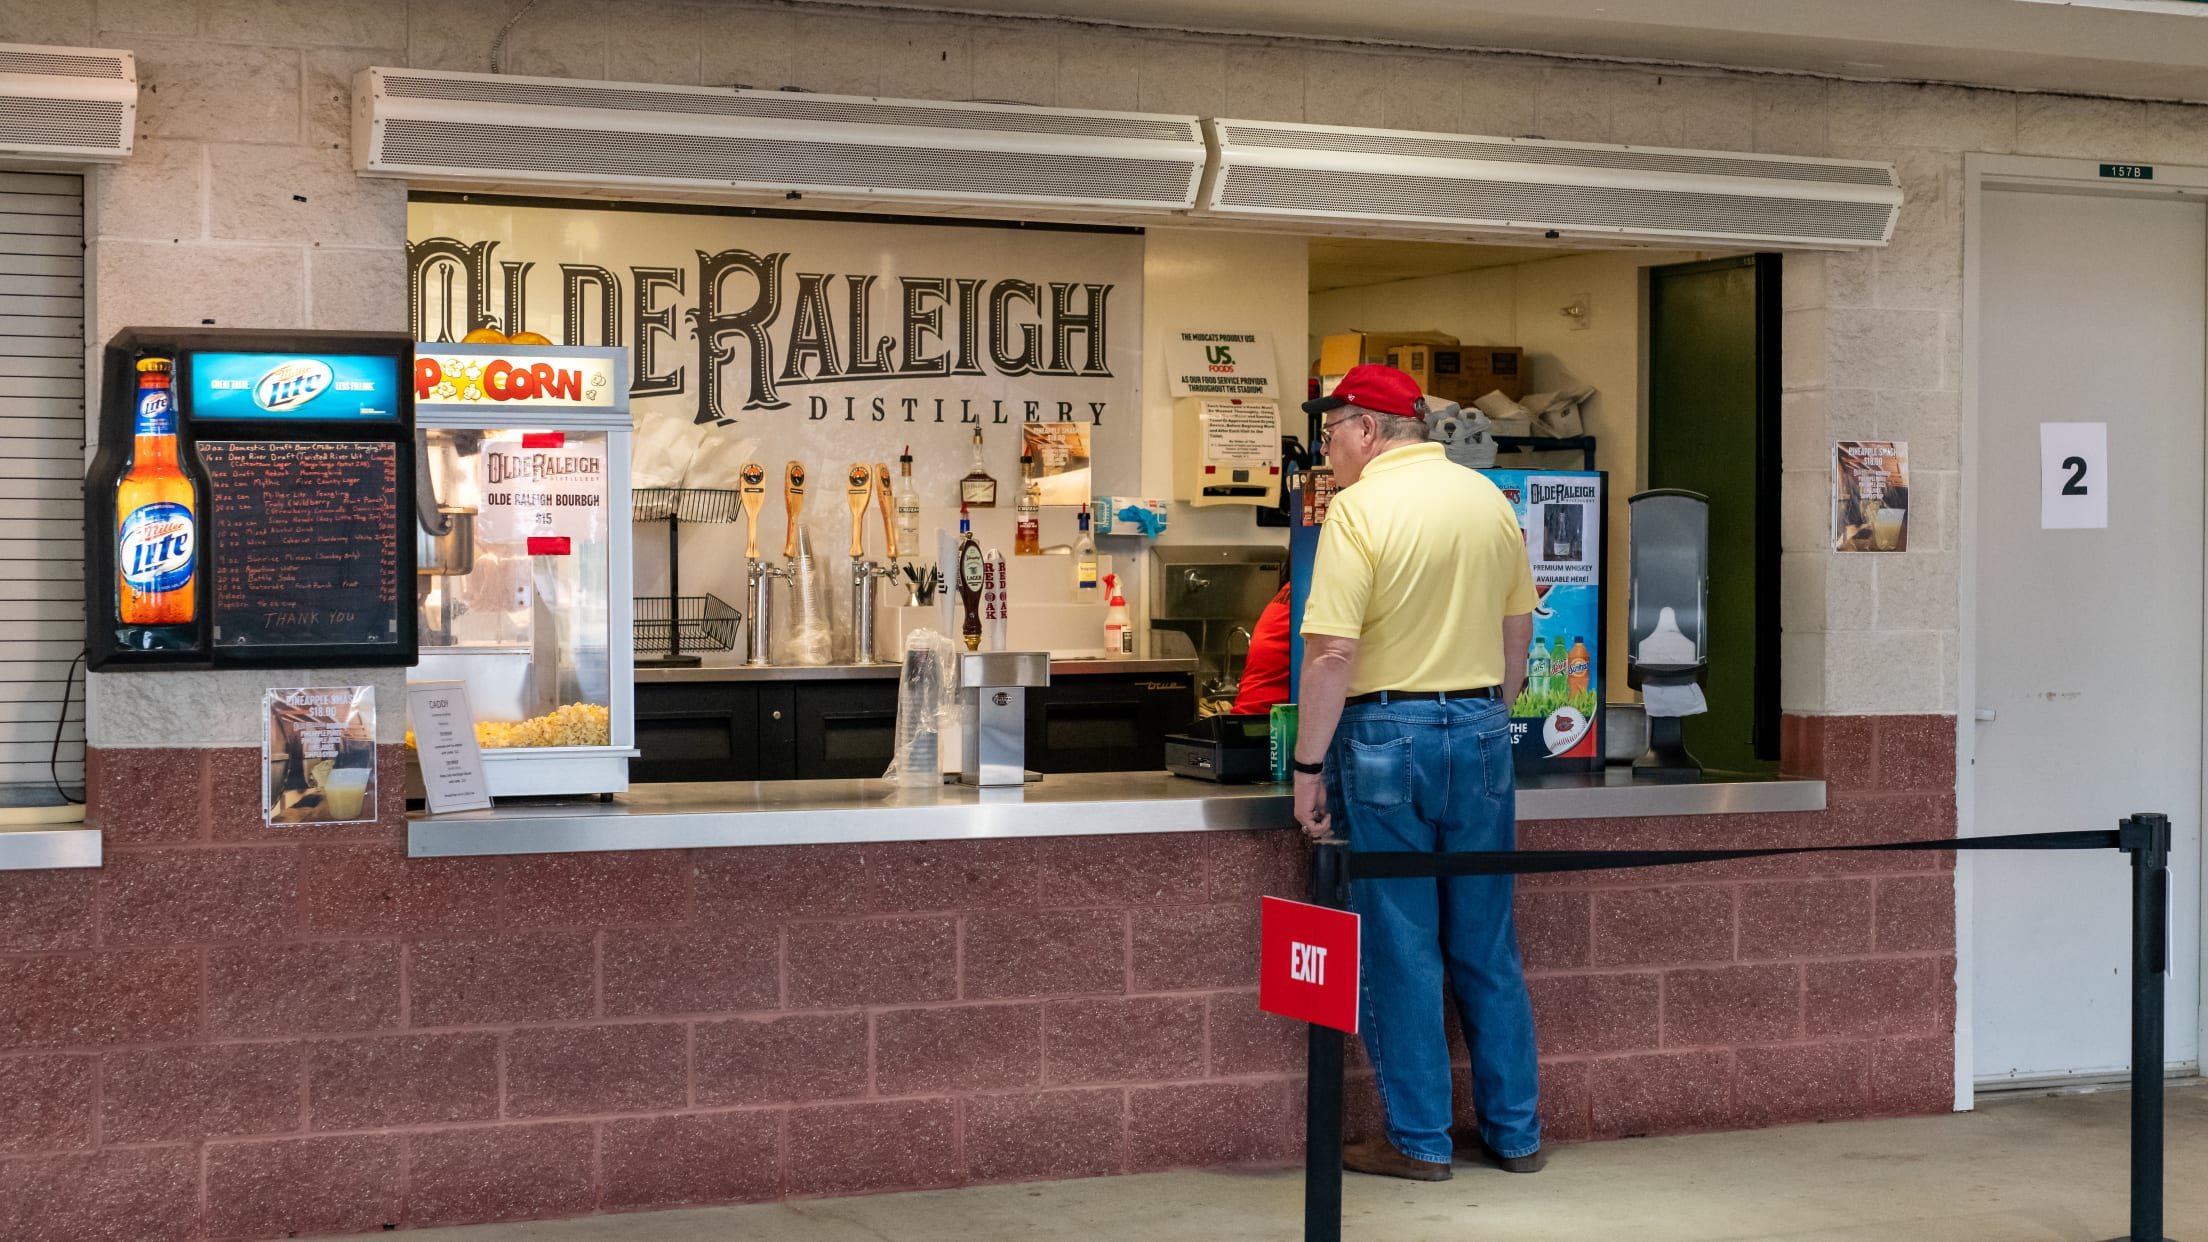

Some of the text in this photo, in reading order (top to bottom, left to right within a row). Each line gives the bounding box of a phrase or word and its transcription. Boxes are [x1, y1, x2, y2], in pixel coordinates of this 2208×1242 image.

[2110, 166, 2141, 178] 157B
[1208, 365, 1234, 373] FOODS
[483, 359, 582, 402] CORN
[1188, 384, 1225, 392] THROUGHOUT
[1240, 377, 1268, 385] PROVIDER
[266, 373, 321, 408] Lite
[144, 397, 168, 415] Lite
[808, 395, 1106, 426] DISTILLERY
[229, 443, 265, 452] Domestic
[269, 443, 293, 452] Draft
[1848, 447, 1878, 456] PINEAPPLE
[228, 453, 246, 463] Deep
[270, 452, 296, 461] Draft
[2061, 456, 2088, 496] 2
[488, 493, 599, 506] OLDE RALEIGH BOURBON
[1556, 484, 1595, 504] RALEIGH
[144, 522, 185, 541] Miller
[131, 532, 188, 577] Lite
[1533, 564, 1593, 572] PREMIUM WHISKEY
[984, 562, 995, 590] RED
[1536, 575, 1589, 583] AVAILABLE HERE!
[263, 609, 355, 629] THANK YOU
[286, 694, 329, 706] PINEAPPLE
[308, 706, 337, 717] $18.00
[1270, 724, 1278, 771] TRULY
[1290, 941, 1327, 986] EXIT
